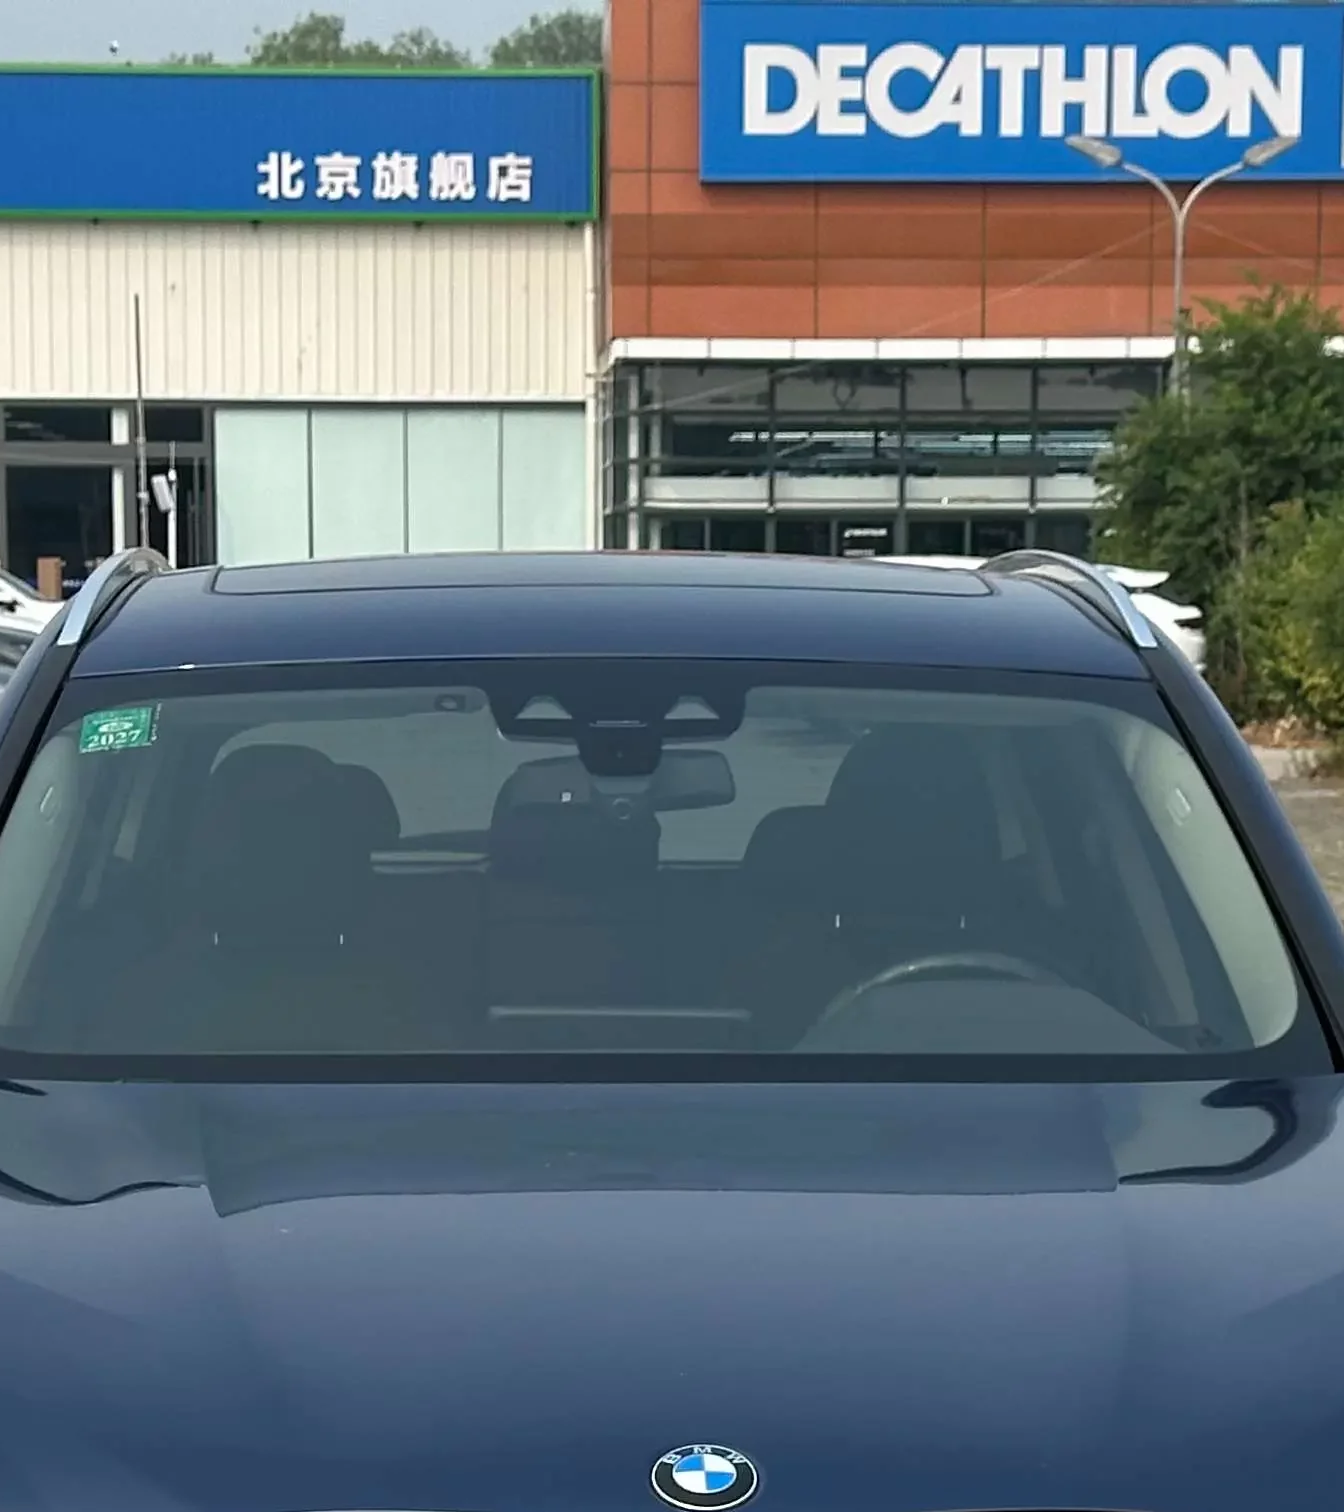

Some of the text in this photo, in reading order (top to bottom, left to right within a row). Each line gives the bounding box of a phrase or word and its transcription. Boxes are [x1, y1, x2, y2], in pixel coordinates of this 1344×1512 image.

[743, 43, 1304, 138] DECATHLON
[256, 151, 534, 203] 北京旗舰店
[86, 728, 143, 749] 2027
